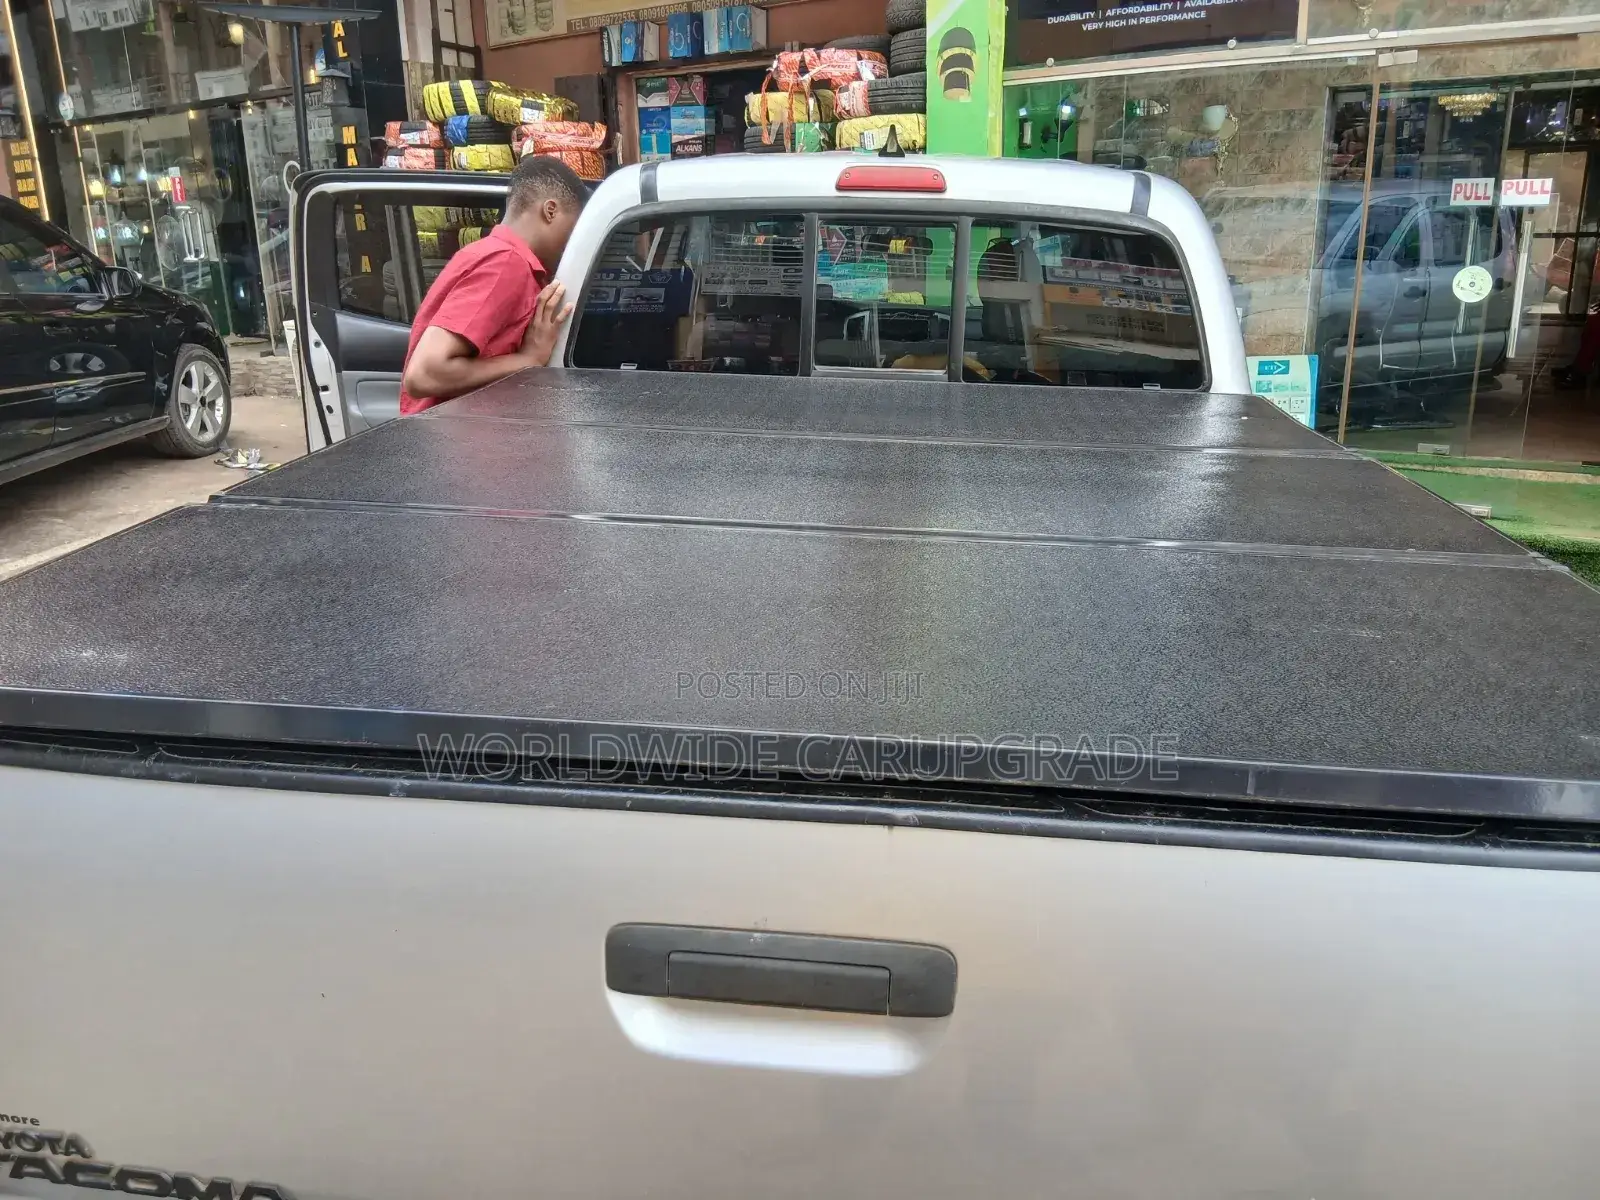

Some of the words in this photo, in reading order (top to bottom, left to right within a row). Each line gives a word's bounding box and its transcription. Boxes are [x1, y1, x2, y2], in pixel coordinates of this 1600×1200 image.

[1047, 11, 1095, 25] DURABILITY
[1105, 2, 1173, 17] AFFORDABILITY
[1184, 0, 1244, 8] AVAILAB
[571, 20, 588, 31] TEL:
[1081, 22, 1103, 31] VERY
[1105, 19, 1126, 28] HIGH
[1128, 18, 1138, 26] IN
[1139, 11, 1206, 25] PERFORMANCE
[676, 144, 702, 153] ALKANS
[1453, 183, 1491, 201] PULL
[1503, 180, 1550, 195] PULL
